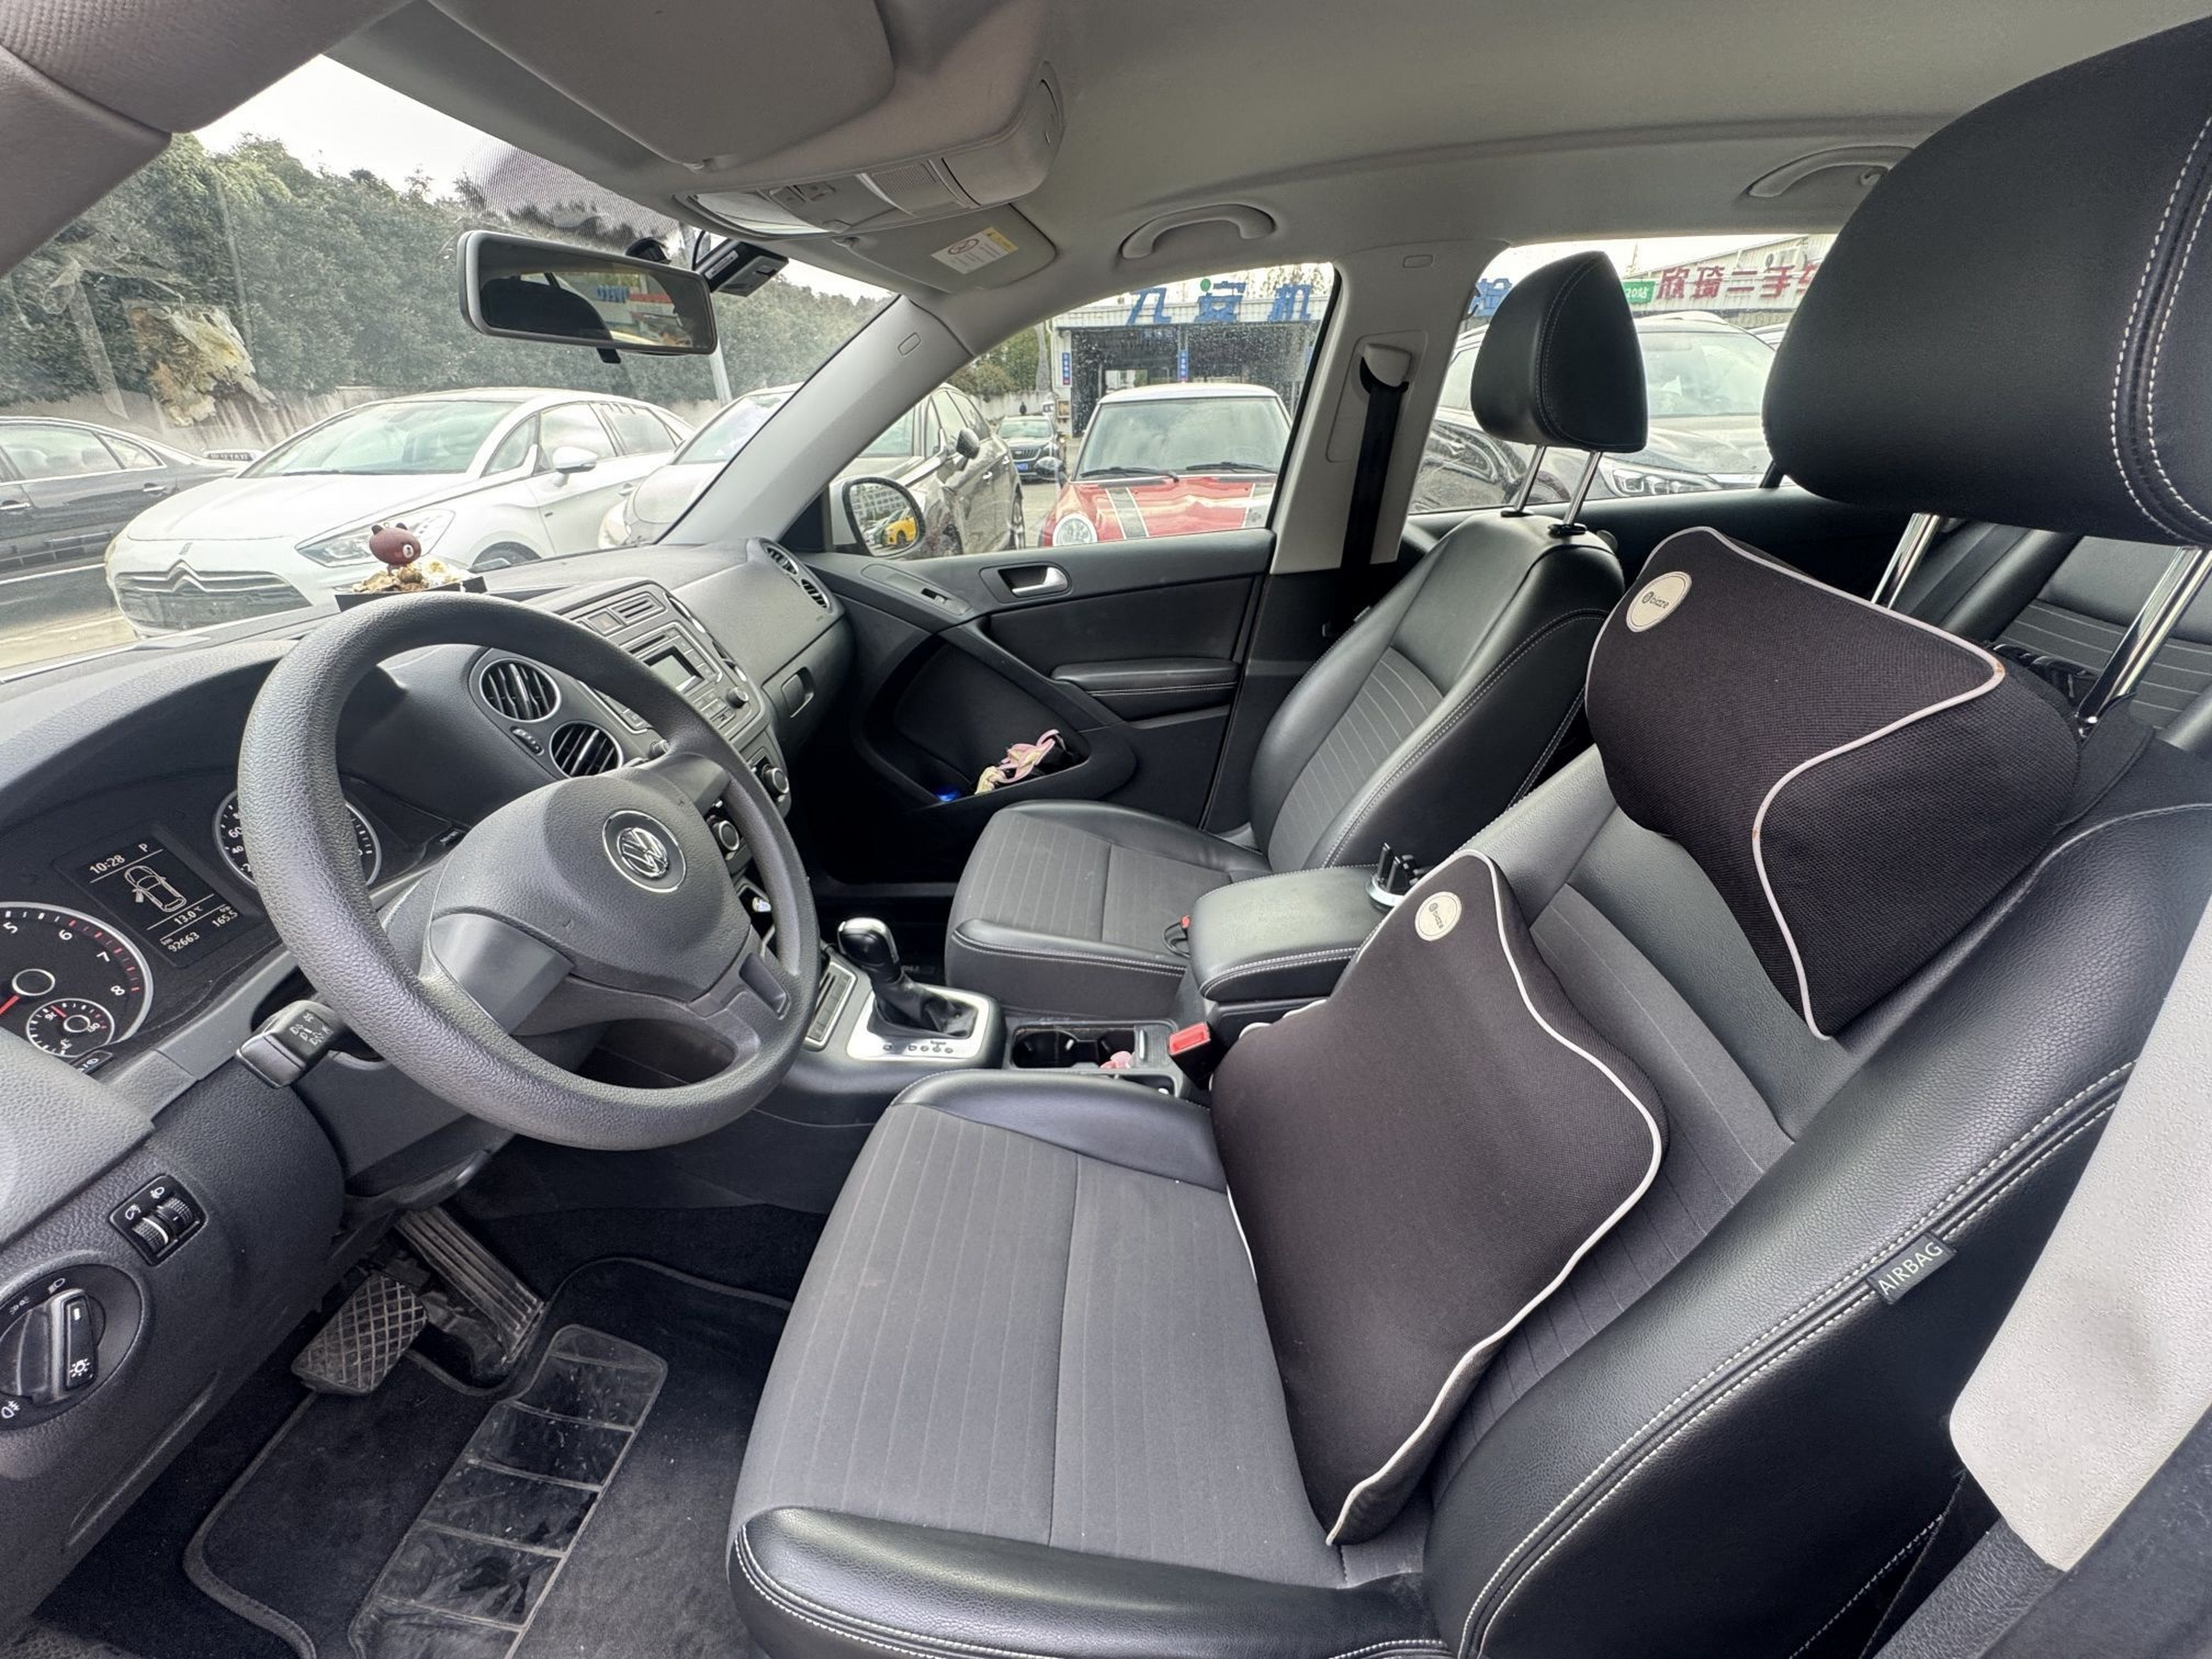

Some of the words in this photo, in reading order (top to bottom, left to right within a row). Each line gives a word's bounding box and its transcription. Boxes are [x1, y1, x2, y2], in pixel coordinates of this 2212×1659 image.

[228, 827, 243, 838] 60
[138, 843, 148, 852] P
[90, 855, 125, 874] 10:28
[174, 910, 196, 925] 13.0
[212, 910, 238, 927] 165.5
[3, 922, 18, 934] 5
[59, 929, 73, 940] 6
[168, 931, 200, 952] 92663
[96, 951, 110, 962] 7
[111, 985, 125, 996] 8
[1878, 1241, 1944, 1295] AIRBAG
